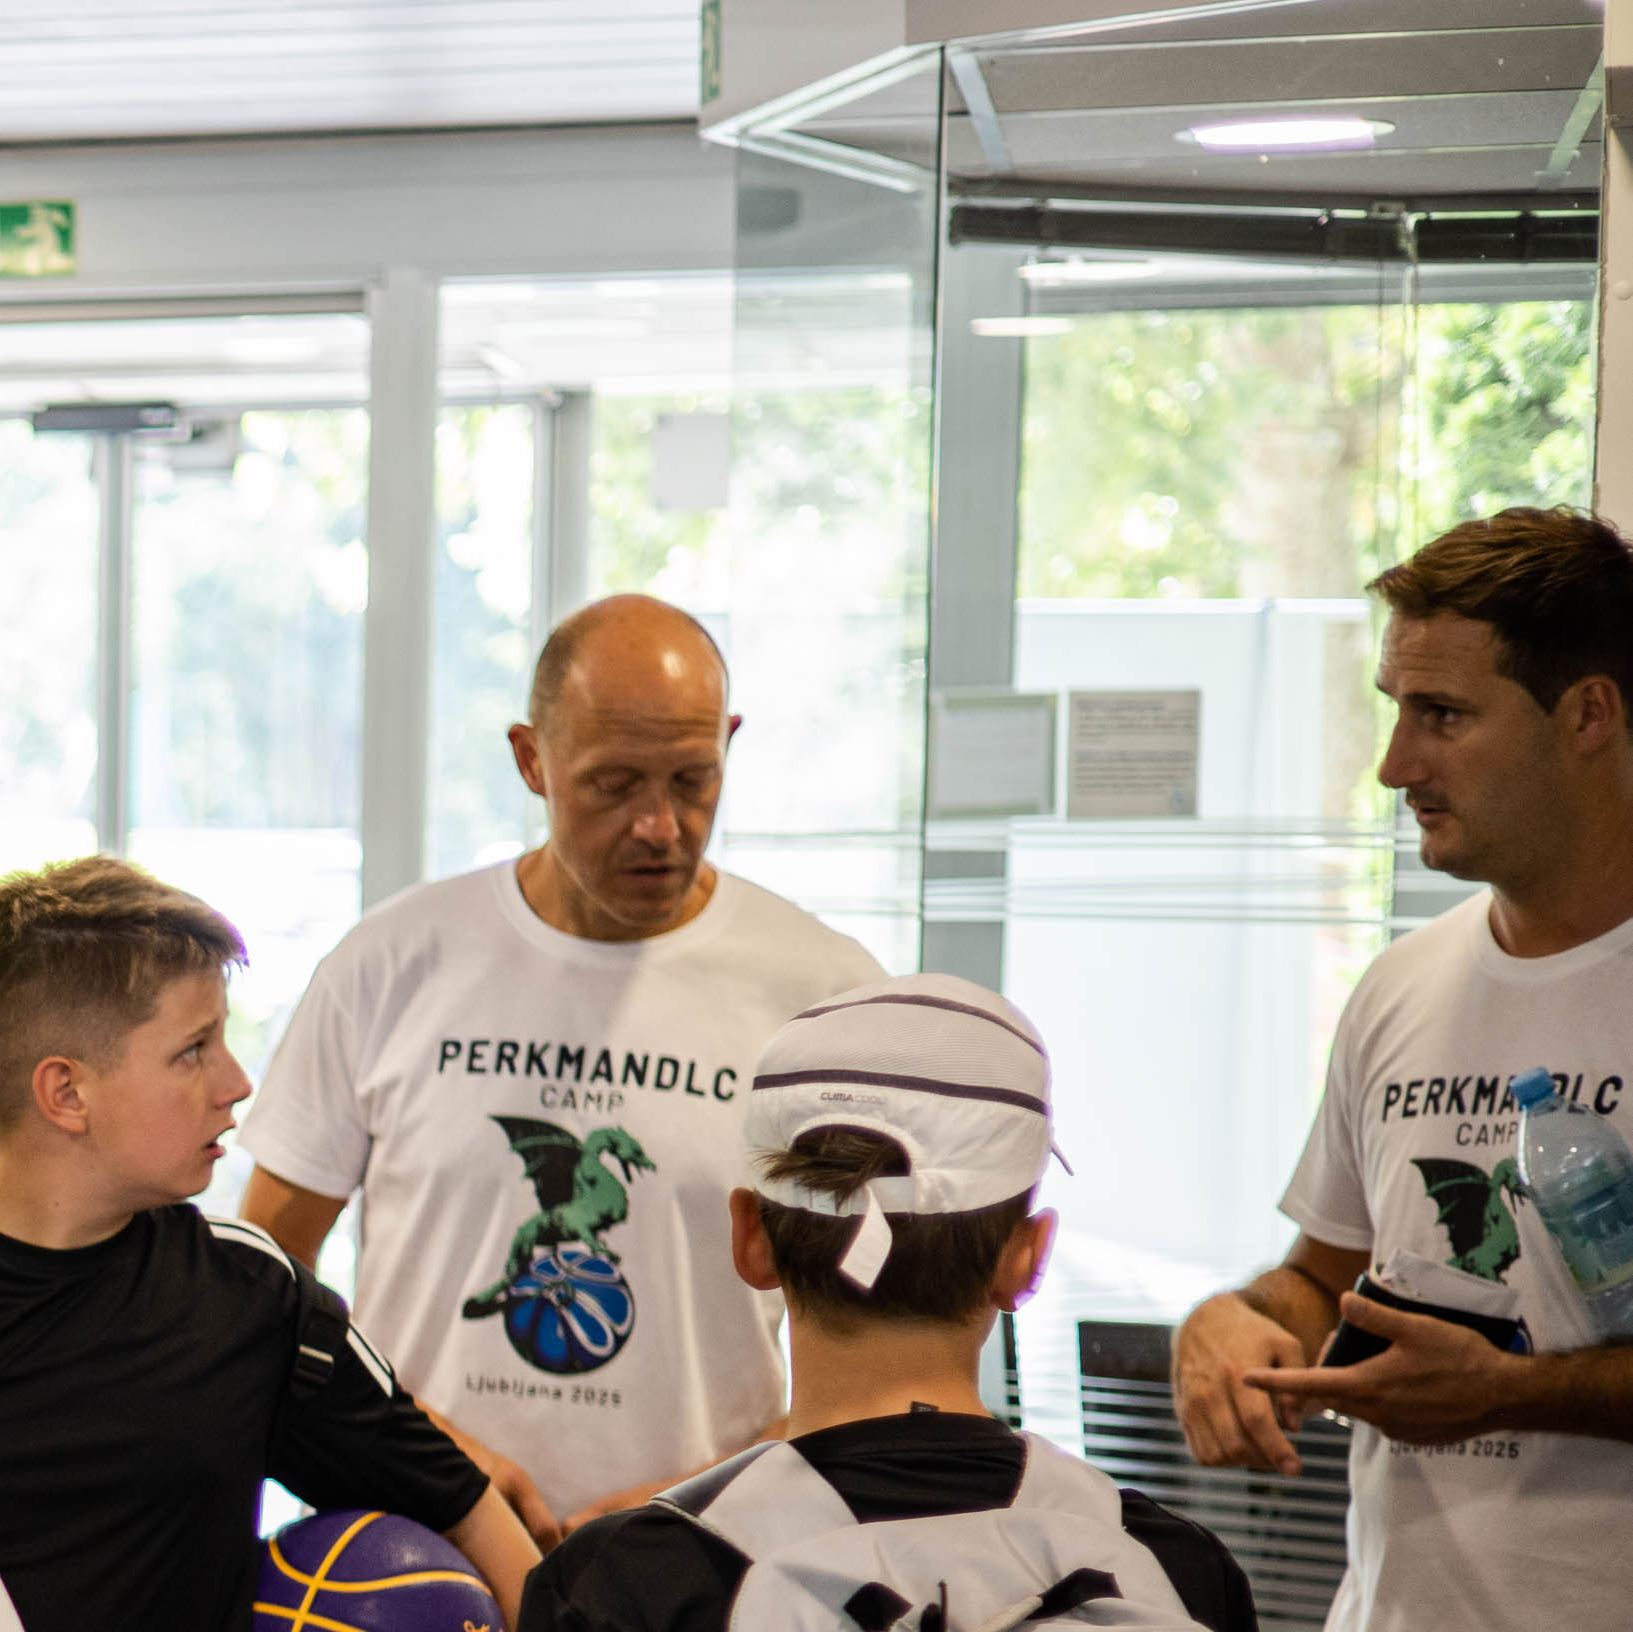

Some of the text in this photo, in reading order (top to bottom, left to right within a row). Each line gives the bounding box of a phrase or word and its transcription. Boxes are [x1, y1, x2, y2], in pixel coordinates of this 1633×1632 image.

[436, 1038, 738, 1103] PERKMANDLC
[539, 1085, 625, 1113] CAMP
[1456, 1121, 1519, 1147] CAMP
[465, 1373, 563, 1398] Ljubljana
